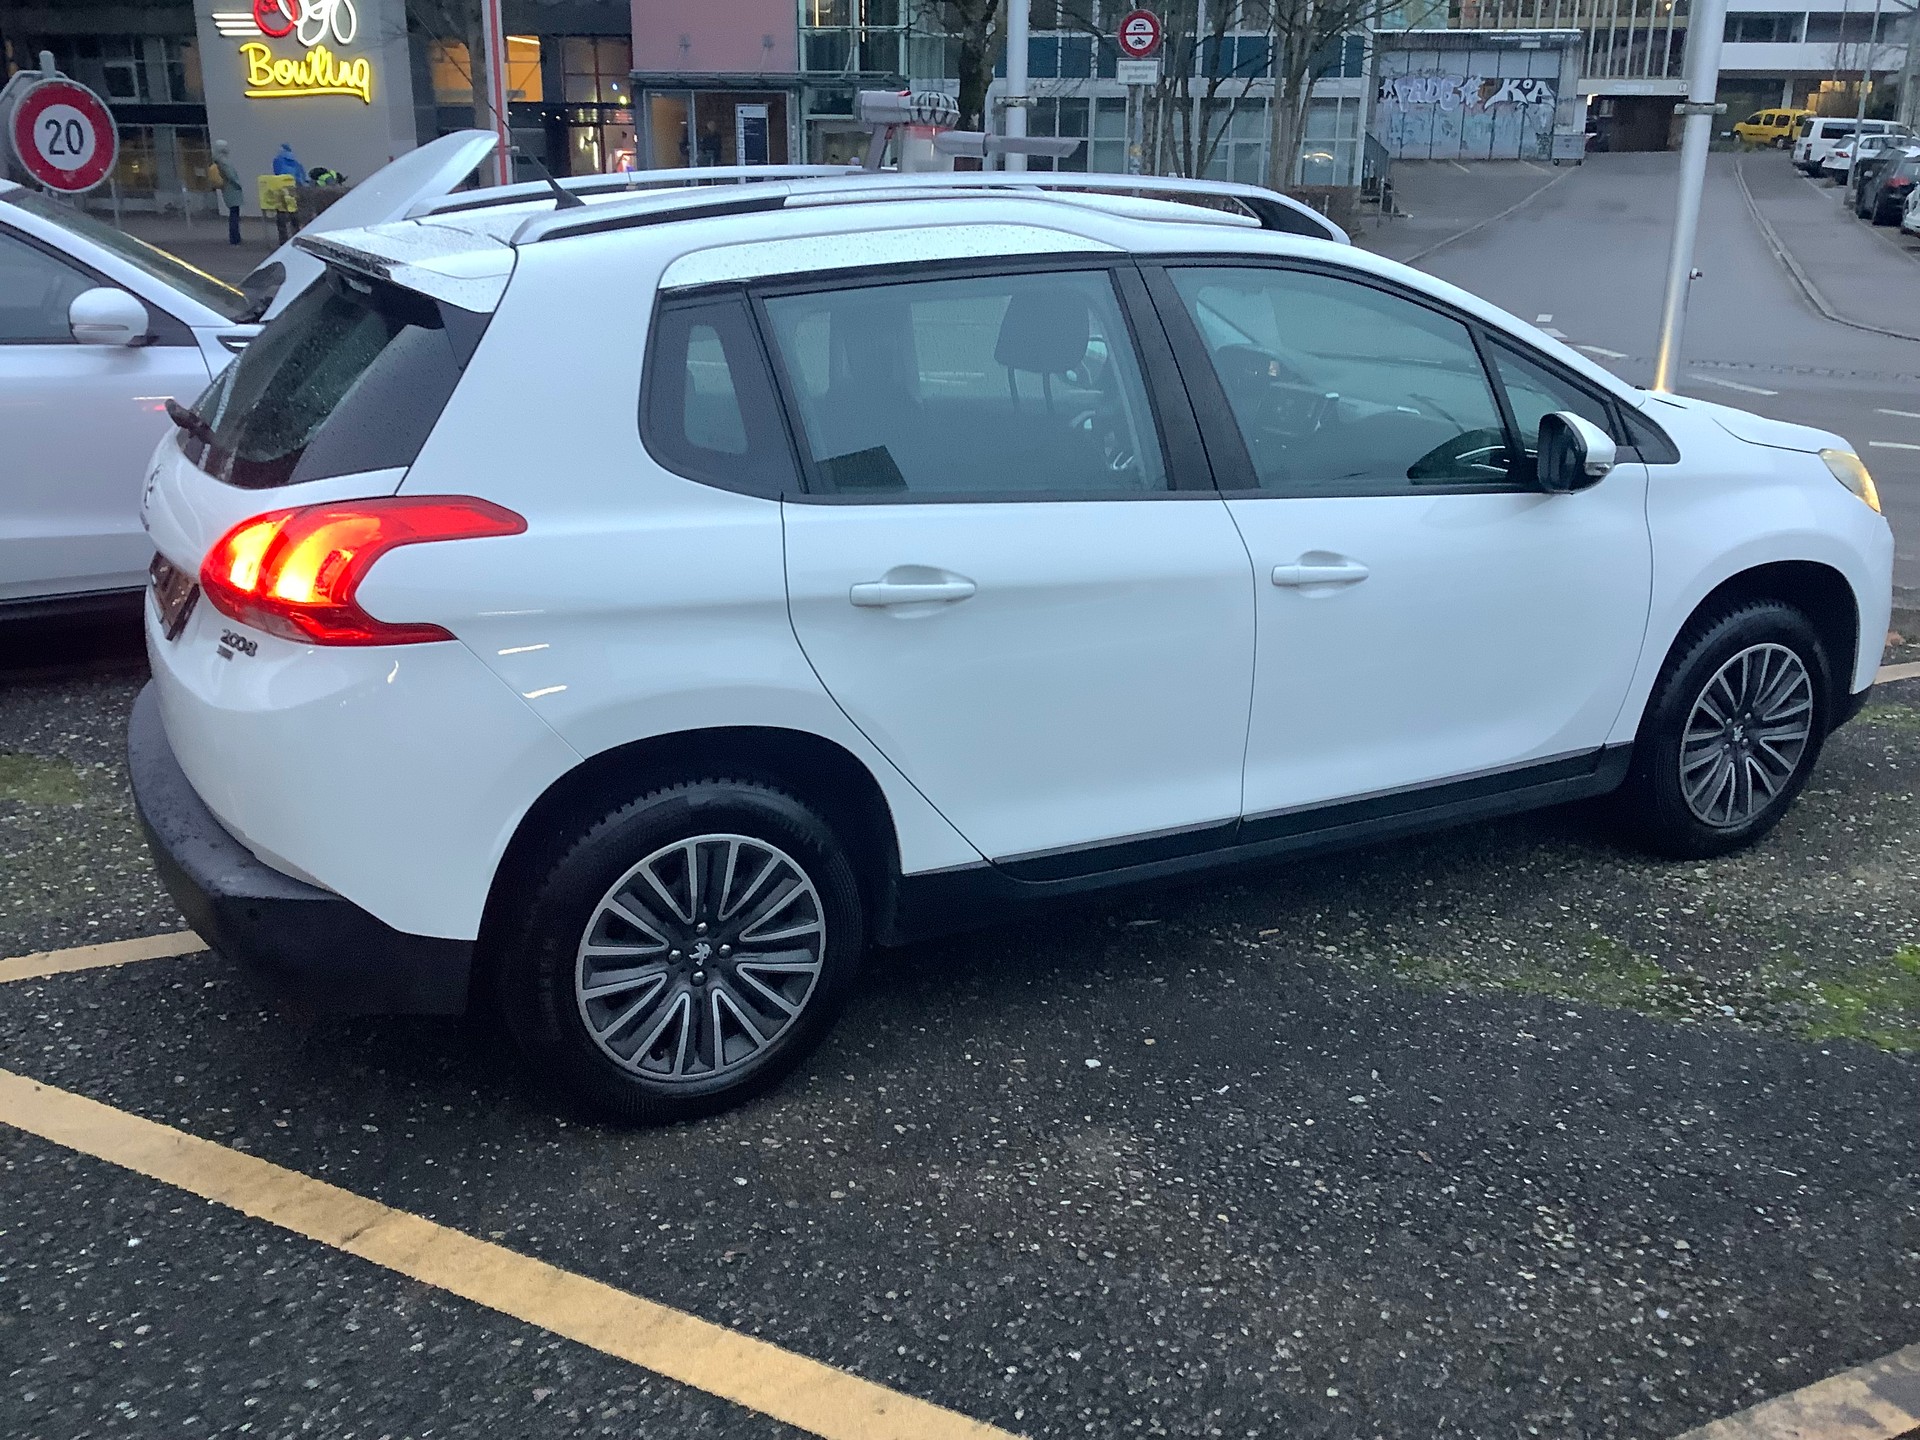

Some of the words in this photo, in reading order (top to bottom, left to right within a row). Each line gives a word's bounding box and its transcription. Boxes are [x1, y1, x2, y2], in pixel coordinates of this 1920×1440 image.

[239, 42, 371, 104] Bowling
[45, 118, 84, 155] 20
[220, 628, 258, 657] 2008
